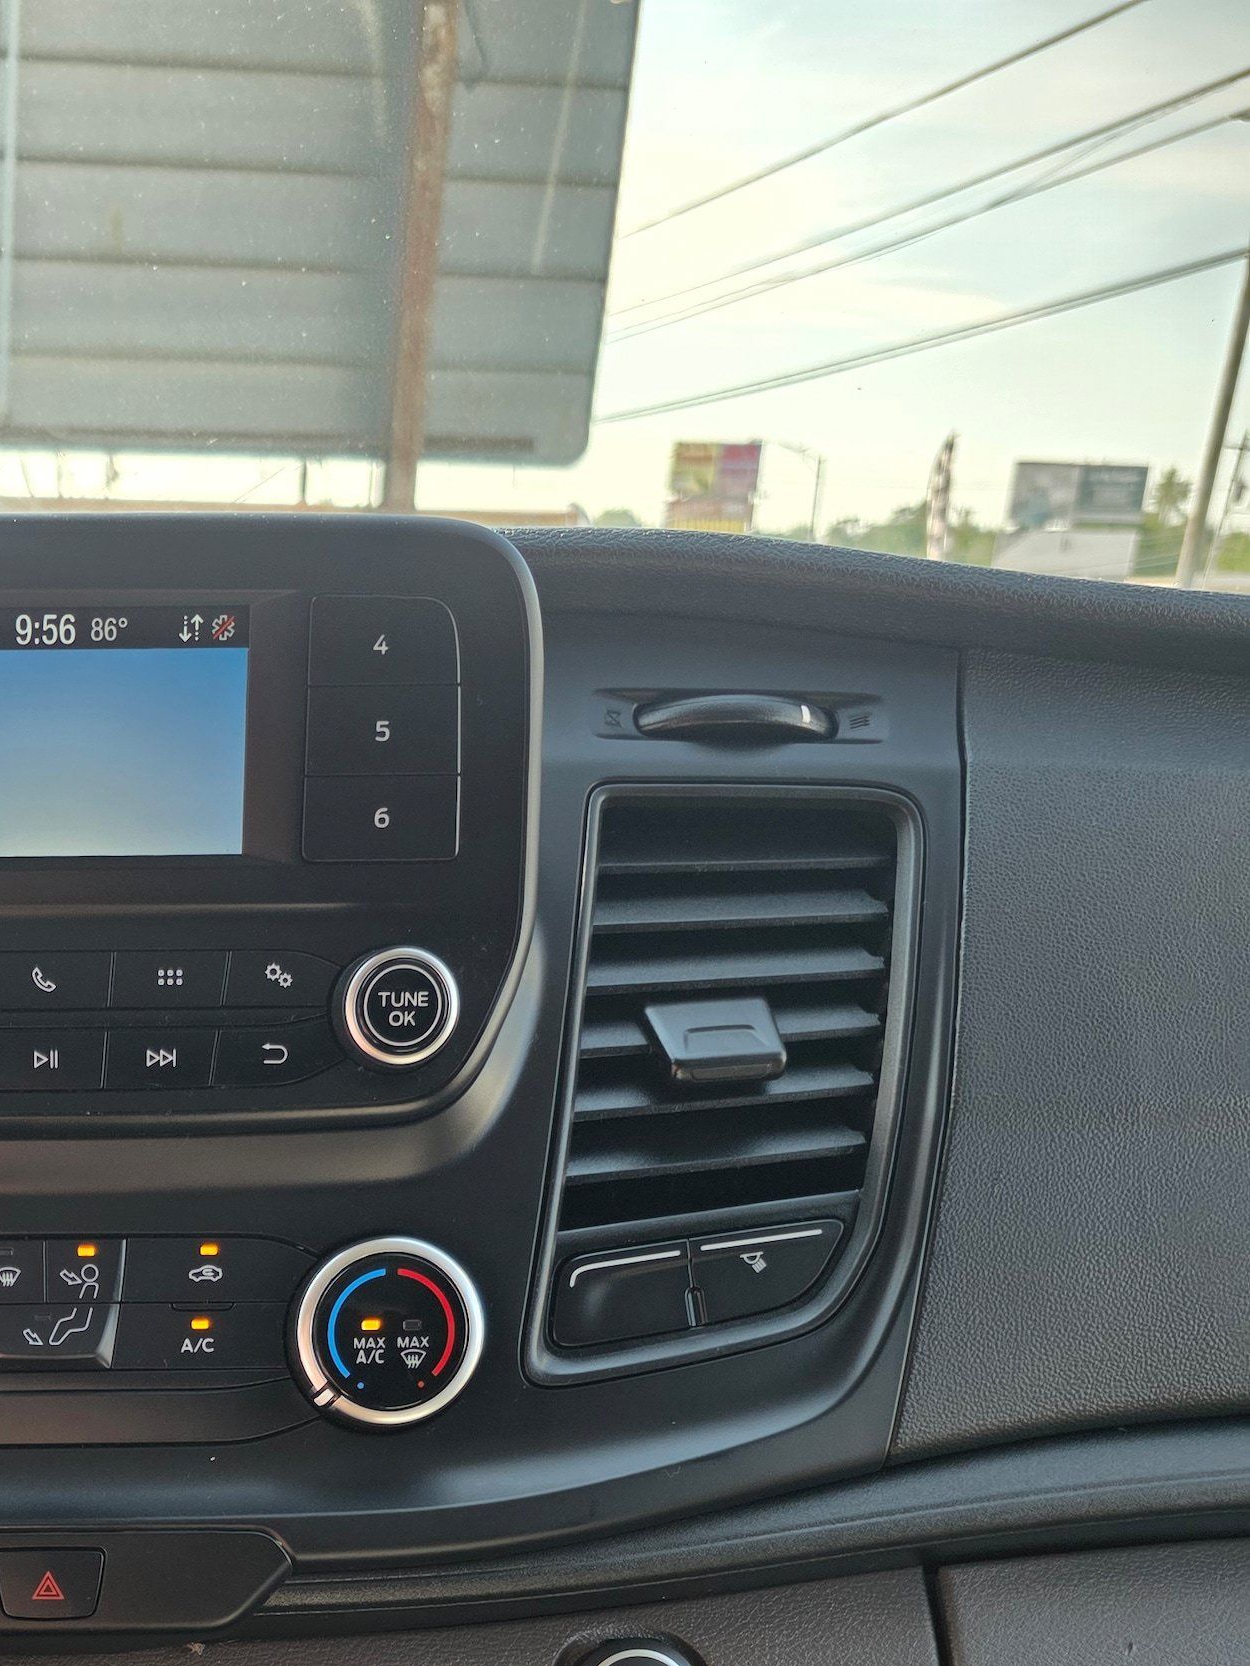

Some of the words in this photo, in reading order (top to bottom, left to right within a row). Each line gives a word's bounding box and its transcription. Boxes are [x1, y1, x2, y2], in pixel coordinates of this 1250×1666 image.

[14, 613, 77, 646] 9:56
[372, 634, 389, 656] 4
[374, 720, 391, 743] 5
[374, 807, 391, 830] 6
[377, 991, 430, 1008] TUNE
[388, 1010, 416, 1027] OK
[180, 1337, 215, 1353] A/C
[353, 1336, 386, 1350] MAX
[396, 1335, 430, 1349] MAX
[355, 1348, 386, 1365] A/C
